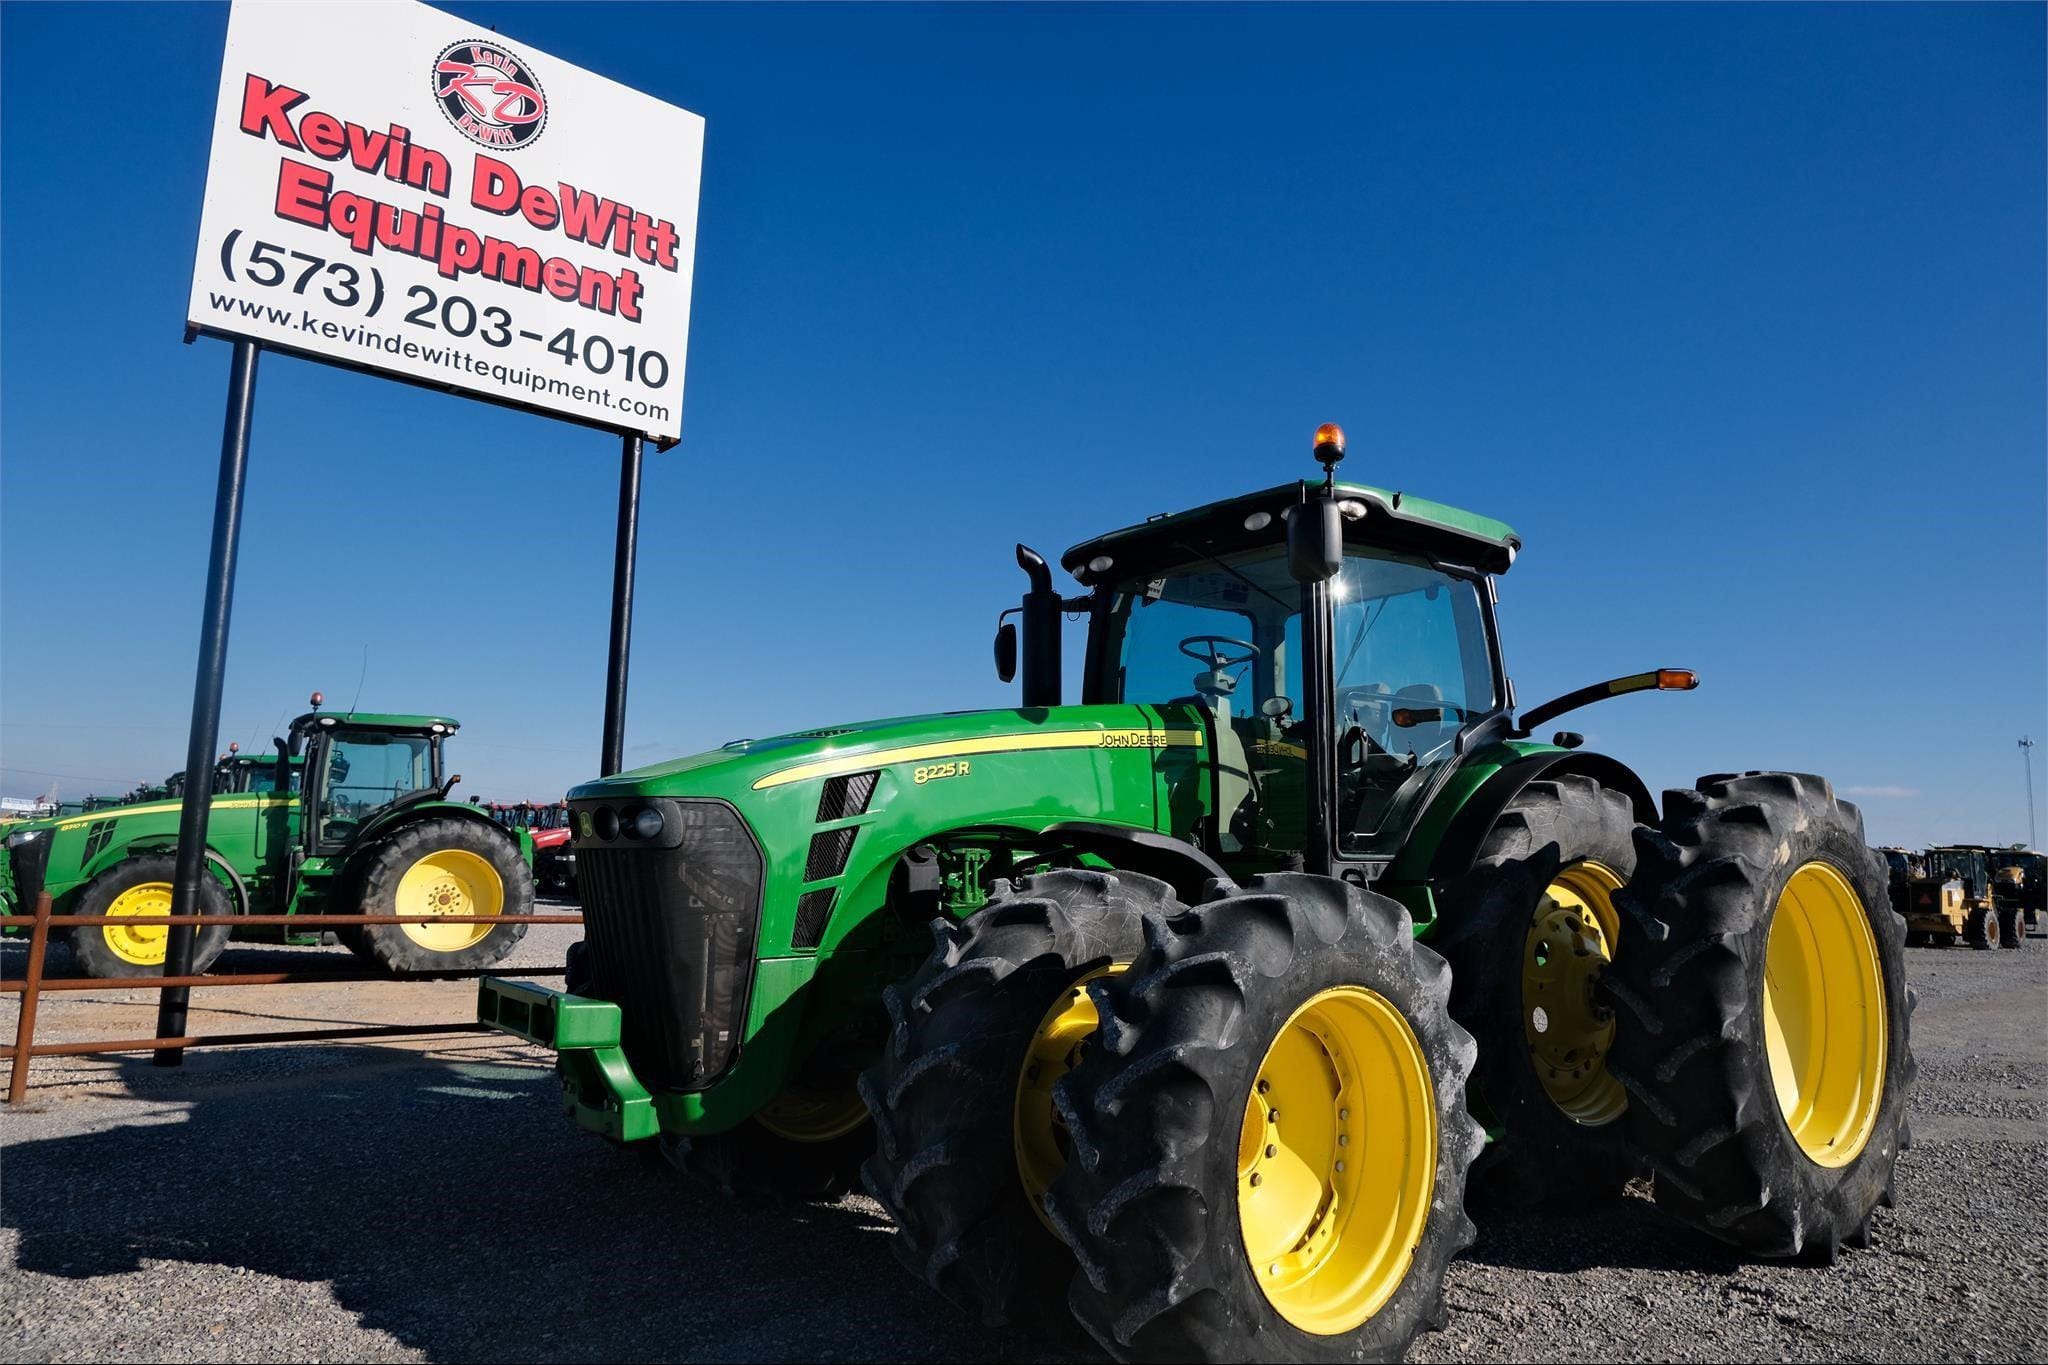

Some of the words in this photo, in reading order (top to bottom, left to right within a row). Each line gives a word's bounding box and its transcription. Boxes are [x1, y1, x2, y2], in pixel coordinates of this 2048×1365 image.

[470, 46, 519, 77] Kevin
[457, 113, 517, 144] DeWitt
[240, 73, 452, 199] Kevin
[471, 153, 681, 273] DeWitt
[275, 157, 644, 324] Equipment
[220, 229, 384, 318] (573)
[404, 285, 669, 389] 203-4010
[209, 292, 669, 422] www.kevindewittequipment.com
[914, 762, 957, 784] 8225
[958, 761, 971, 776] R
[1099, 727, 1129, 747] JOHN
[1130, 727, 1167, 747] DEERE
